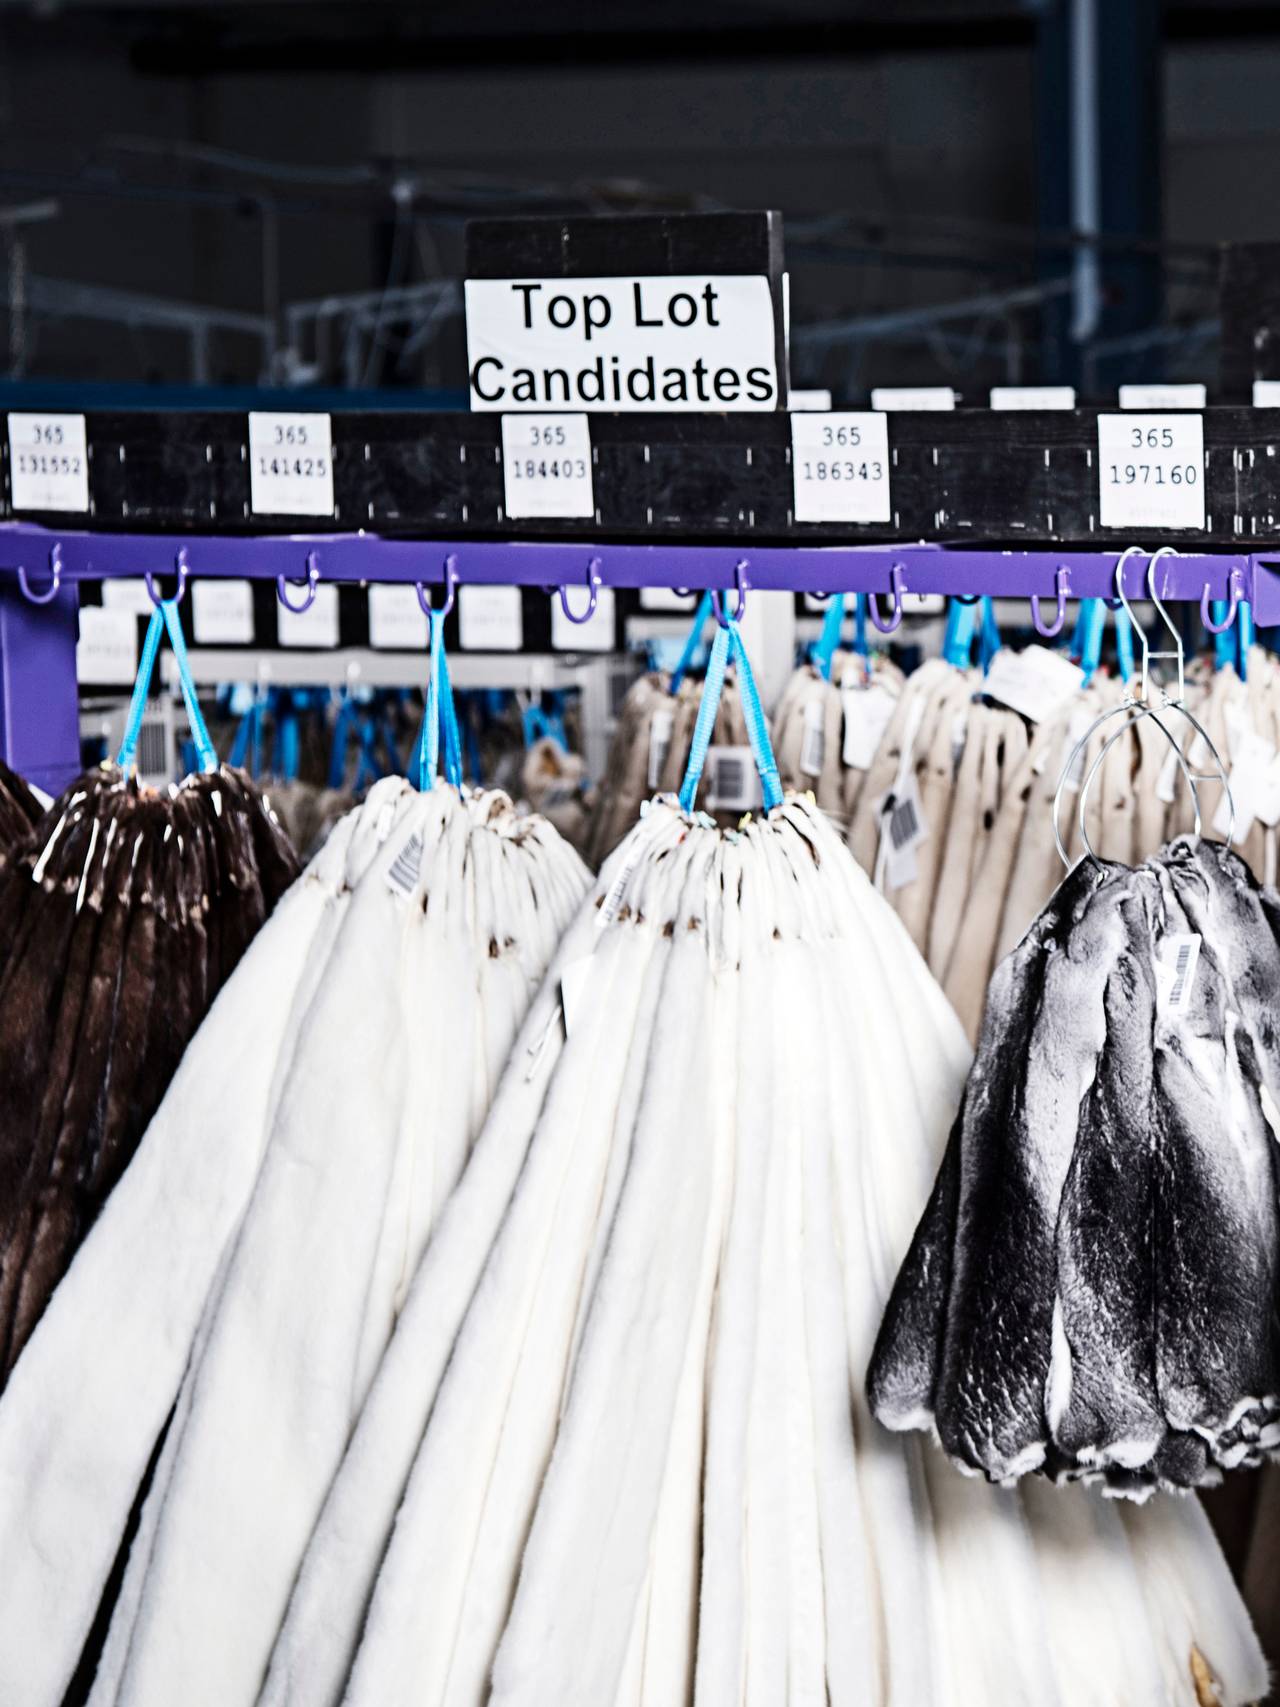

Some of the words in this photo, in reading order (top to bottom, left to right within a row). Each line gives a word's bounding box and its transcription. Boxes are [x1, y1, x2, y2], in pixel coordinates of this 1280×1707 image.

[511, 283, 612, 341] Top
[633, 282, 720, 328] Lot
[471, 354, 776, 405] Candidates
[32, 424, 63, 445] 365
[275, 425, 308, 445] 365
[530, 426, 566, 446] 365
[822, 426, 861, 446] 365
[1131, 427, 1174, 449] 365
[19, 454, 80, 475] 131552
[259, 457, 326, 478] 141425
[513, 459, 586, 480] 184403
[804, 461, 882, 482] 186343
[1109, 464, 1197, 486] 197160
